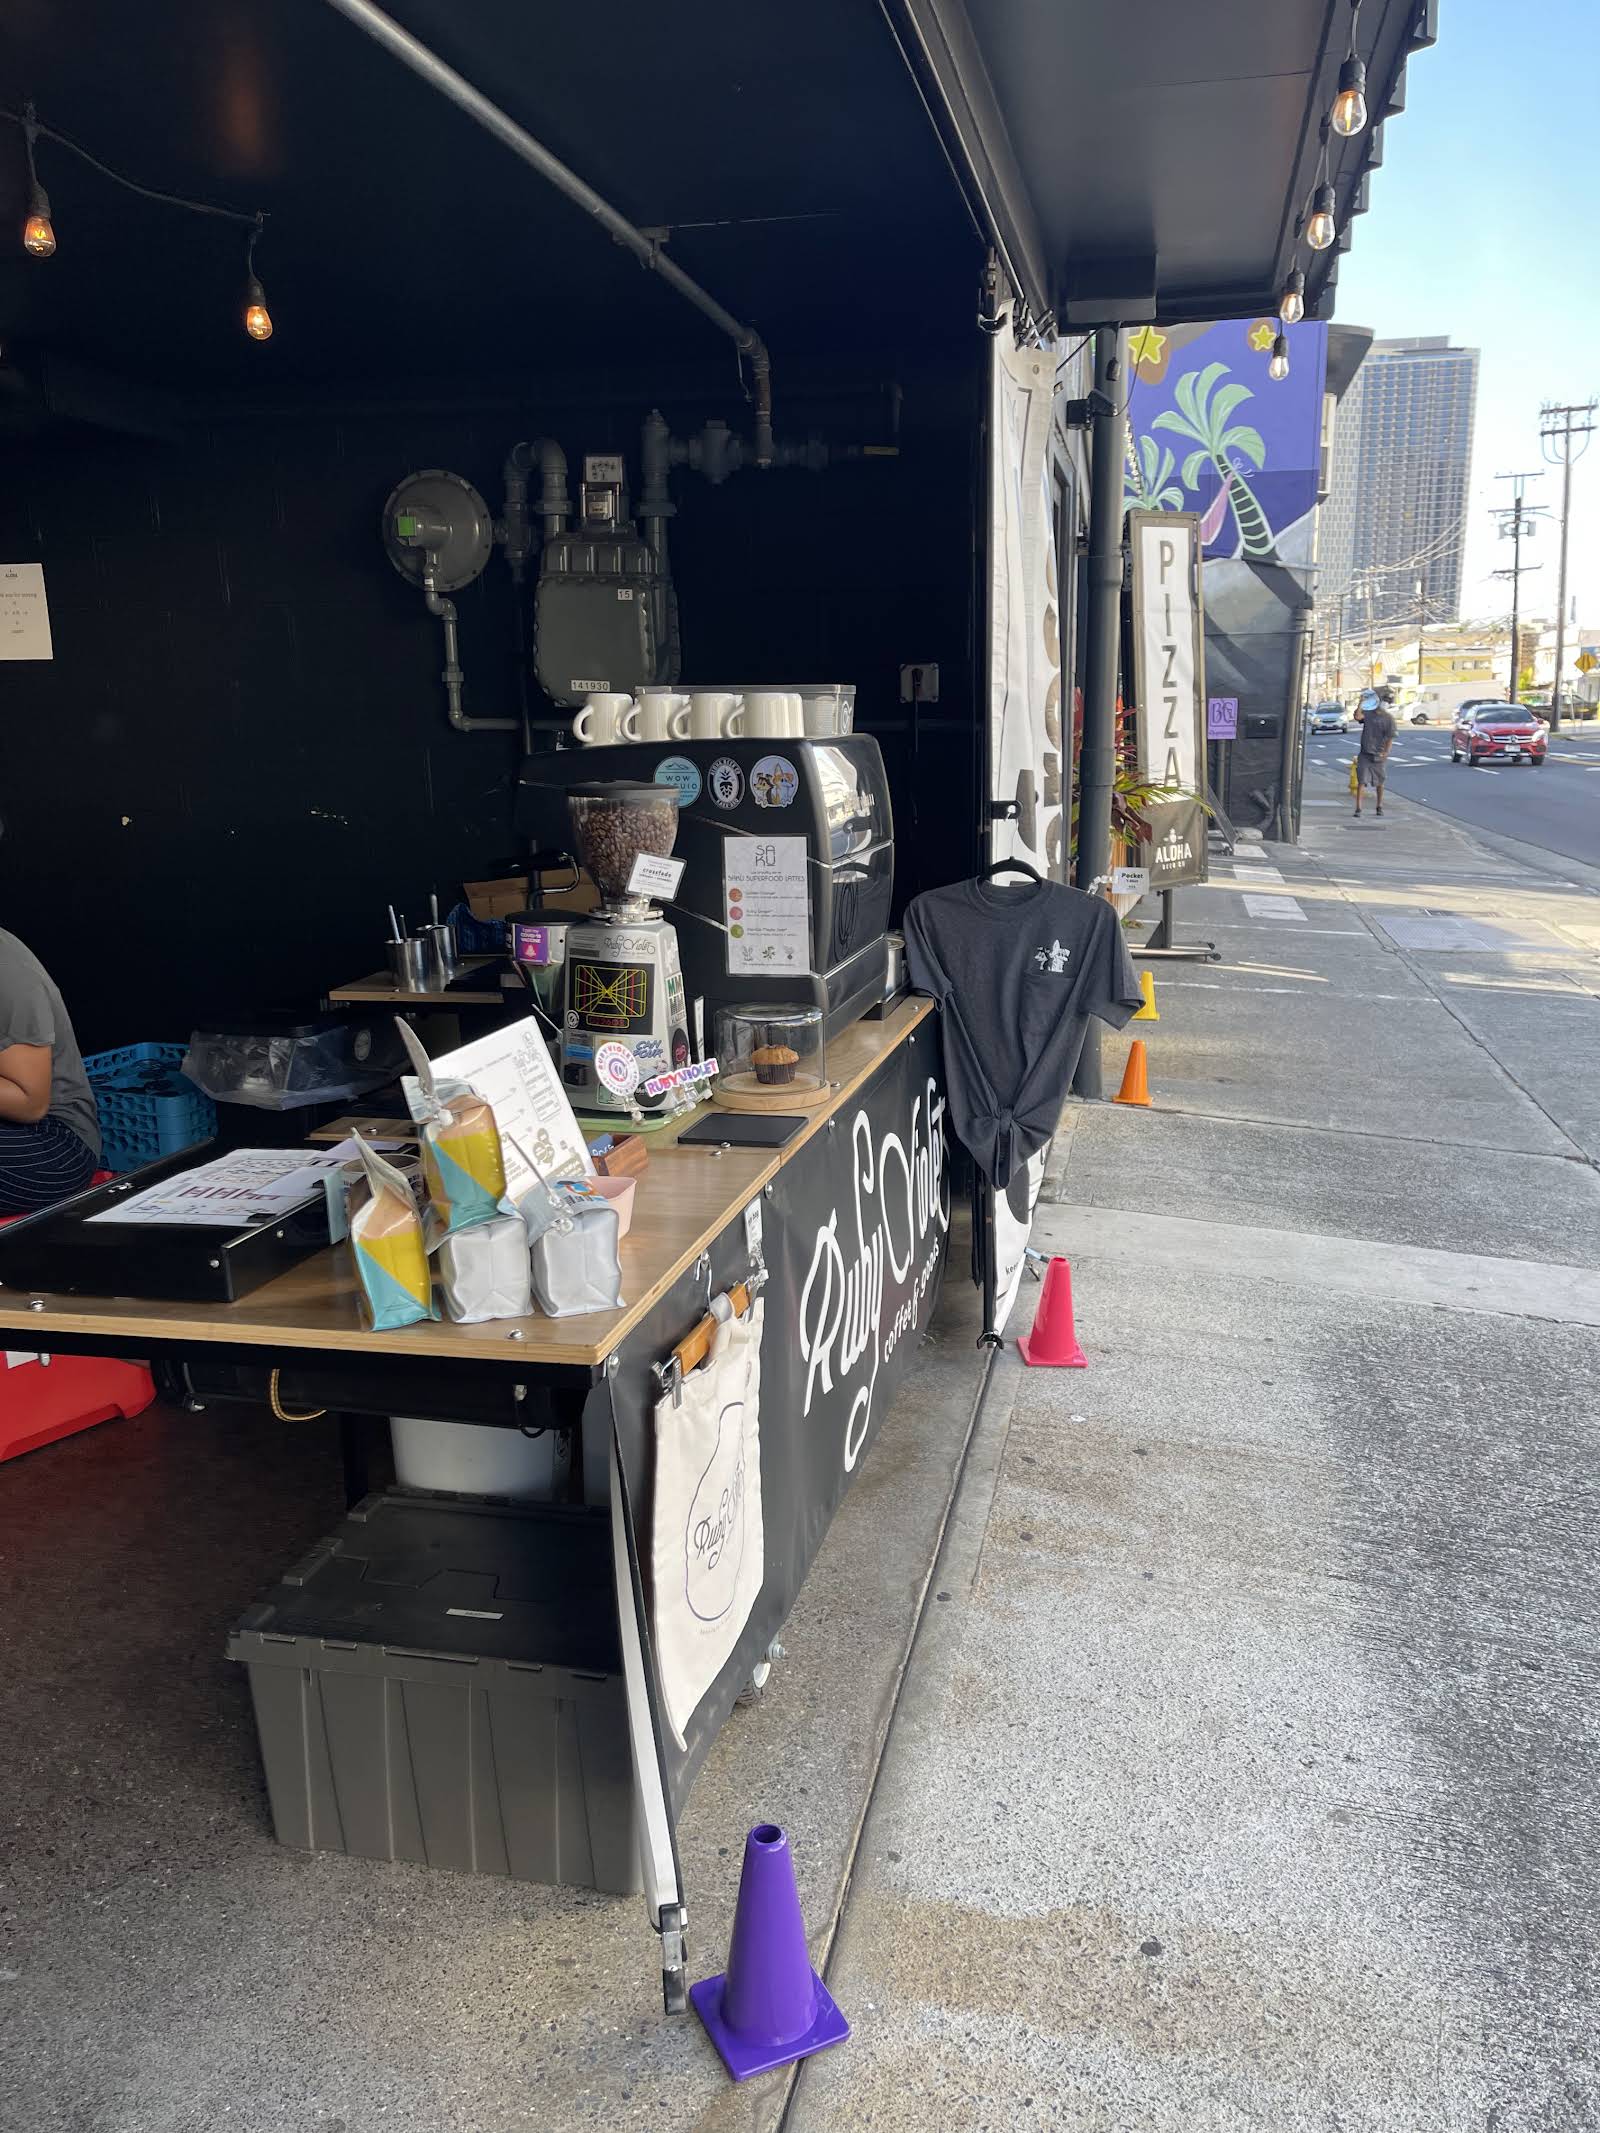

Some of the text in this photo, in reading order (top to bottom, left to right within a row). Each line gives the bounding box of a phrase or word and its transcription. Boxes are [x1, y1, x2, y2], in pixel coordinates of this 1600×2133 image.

[618, 590, 630, 599] 15
[1158, 539, 1182, 788] PIZZA
[572, 681, 609, 691] 141930
[1155, 842, 1193, 864] ALOHA
[1162, 861, 1176, 871] BEER
[746, 874, 783, 882] SUPERFOOD
[799, 1076, 952, 1473] Ruby Violet
[884, 1236, 940, 1364] coffee & goods
[693, 1487, 729, 1570] Ruby
